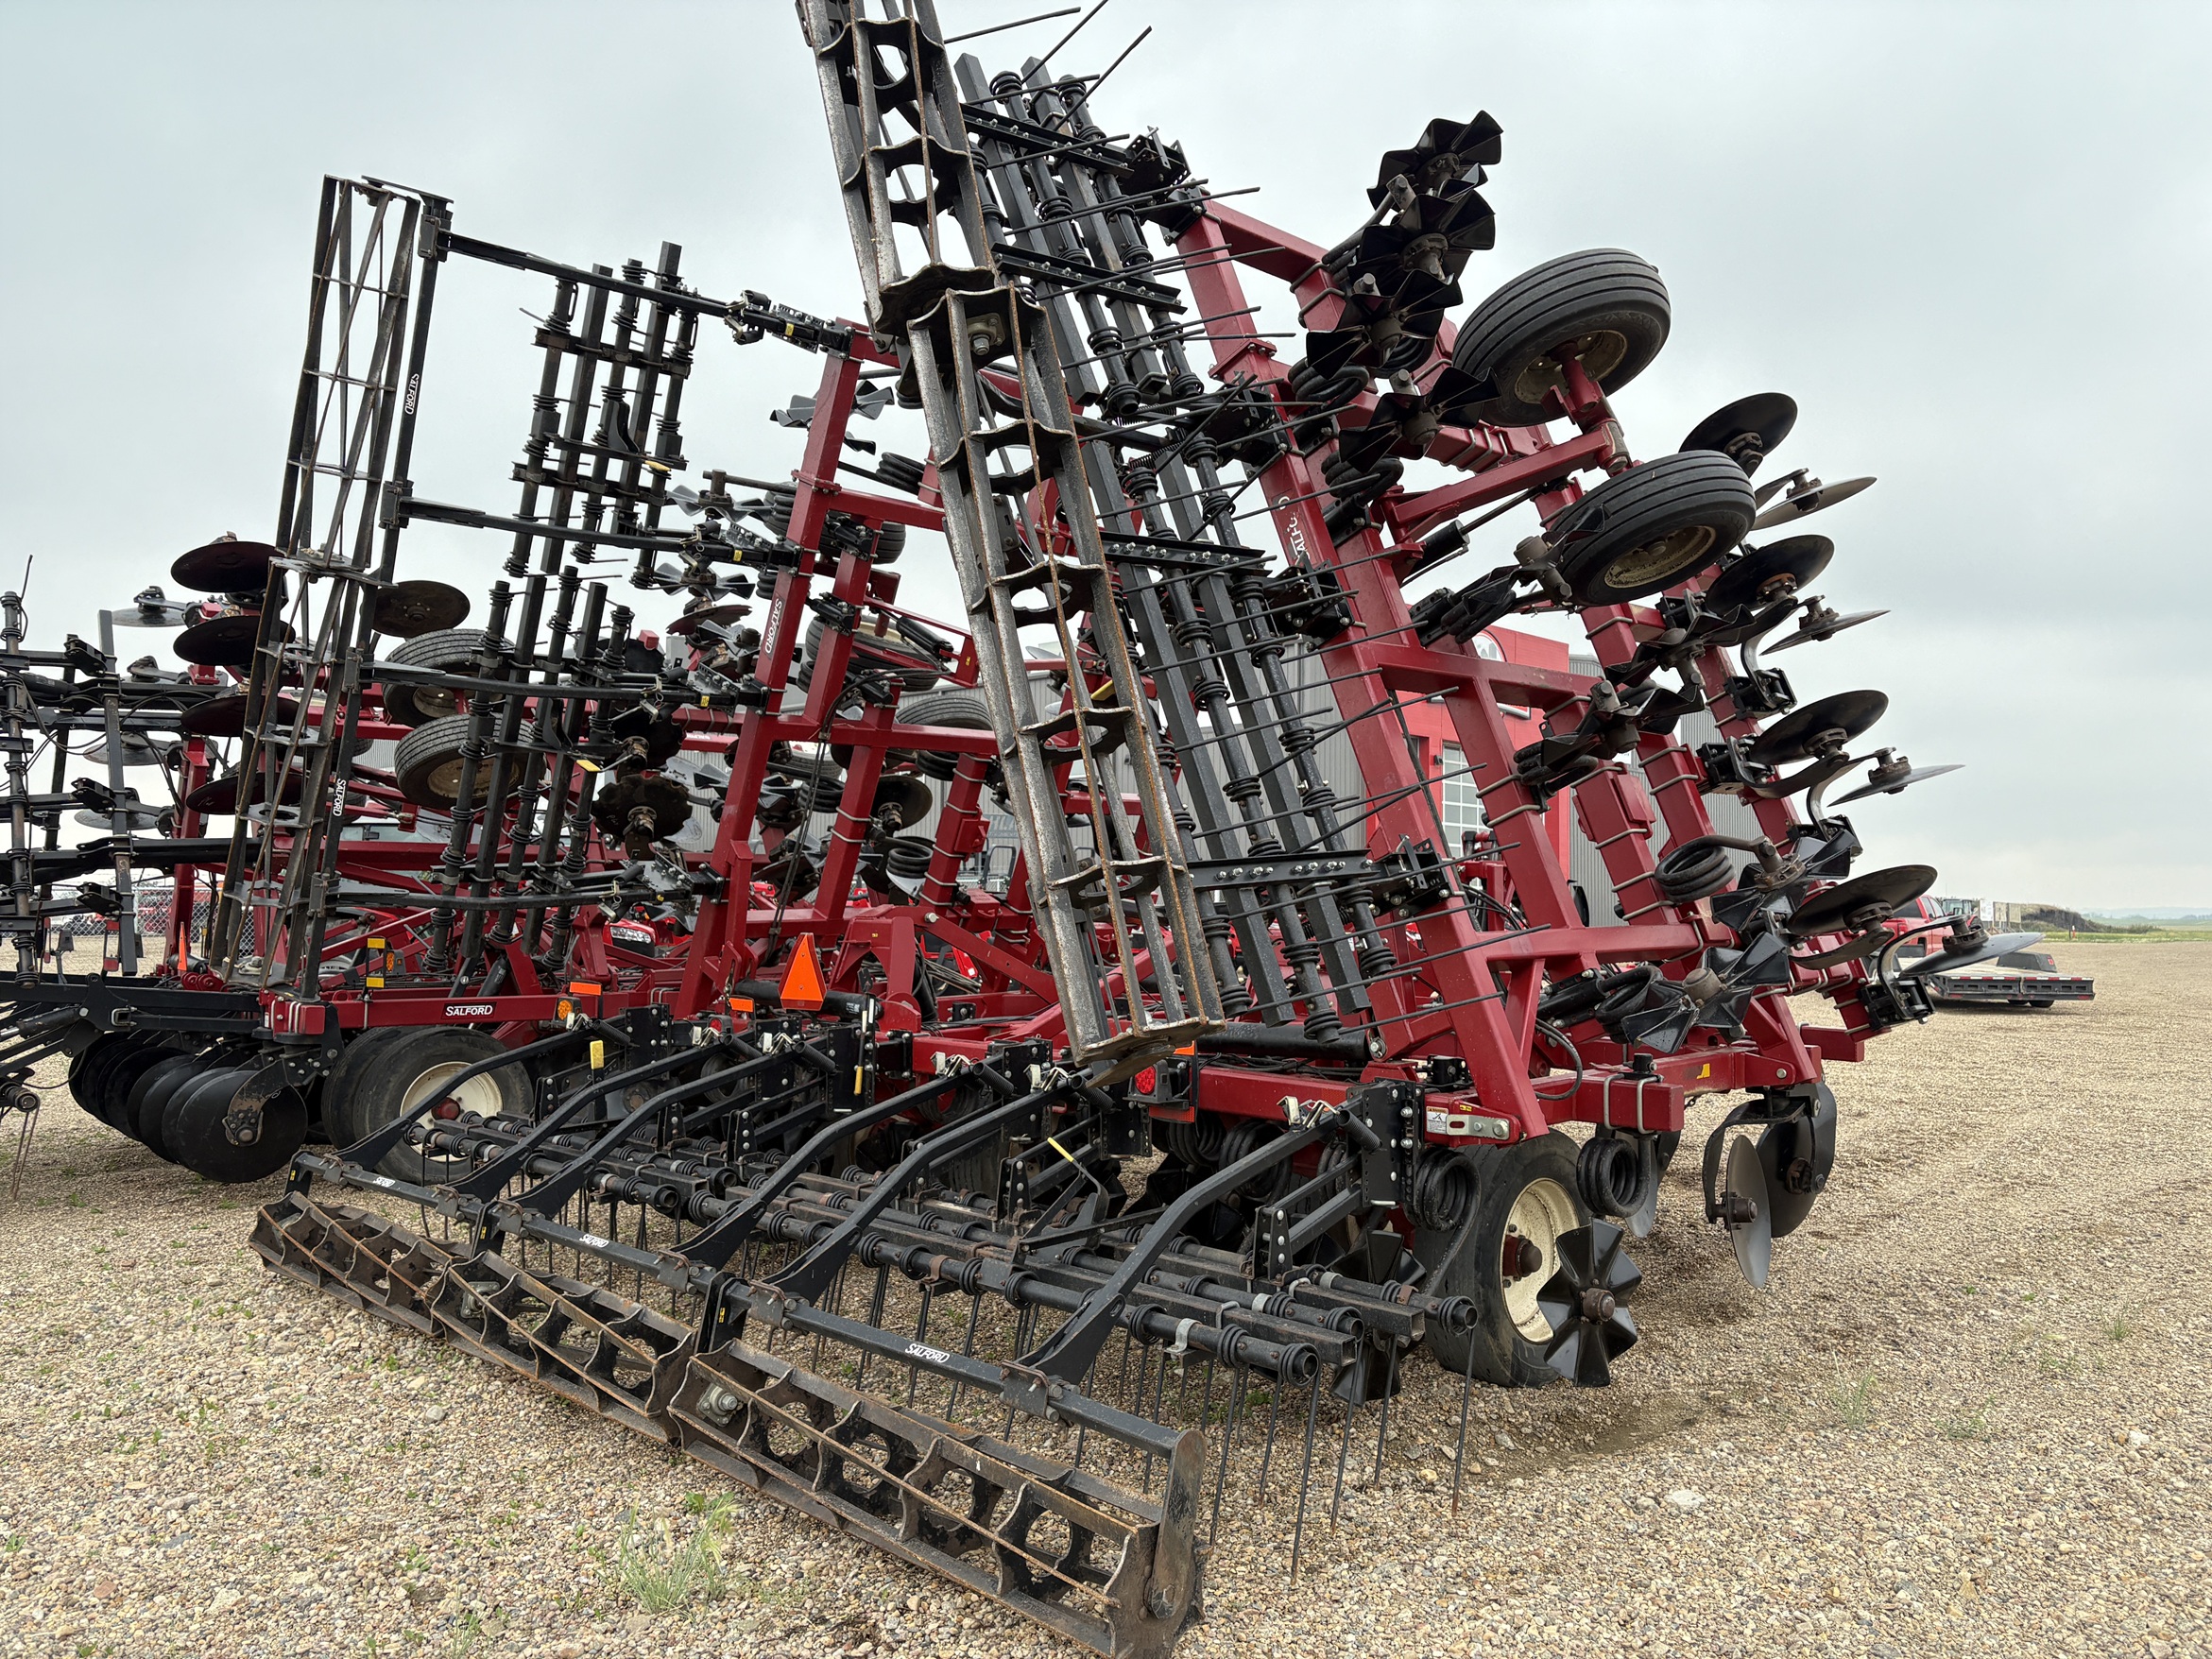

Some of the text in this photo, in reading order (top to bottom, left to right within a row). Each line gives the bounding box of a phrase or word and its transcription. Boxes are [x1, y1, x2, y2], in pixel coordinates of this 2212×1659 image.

[404, 373, 420, 415] SALFORD
[765, 598, 782, 654] SALFORD
[333, 778, 347, 816] SALFORD
[445, 1004, 493, 1017] SALFORD
[578, 1233, 609, 1248] SALFORD
[904, 1343, 951, 1363] SALFORD
